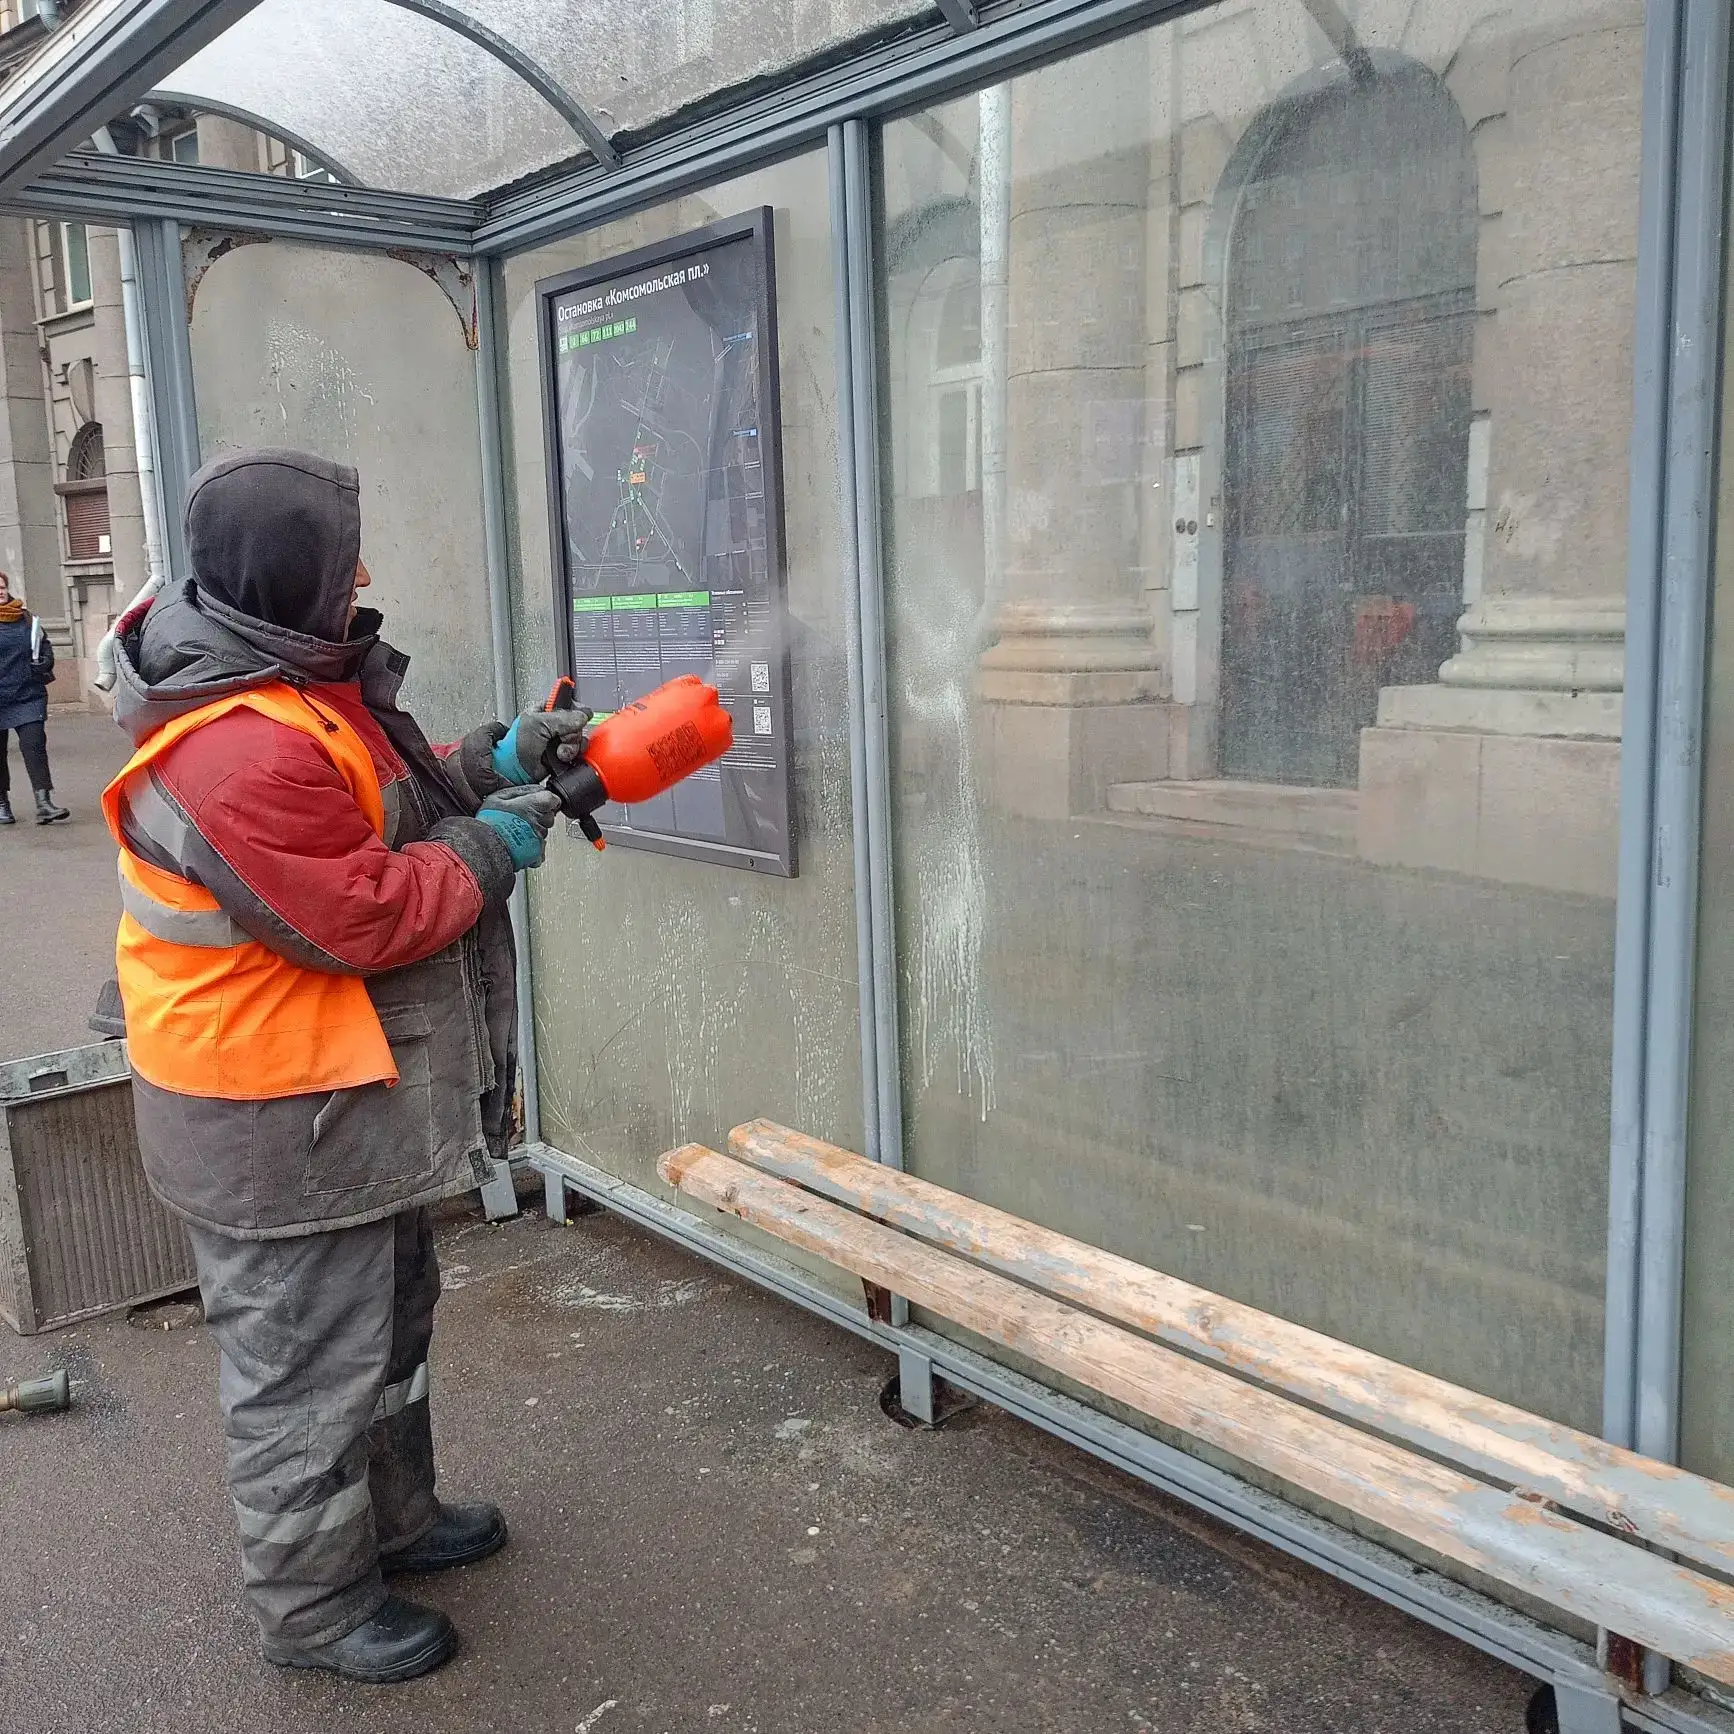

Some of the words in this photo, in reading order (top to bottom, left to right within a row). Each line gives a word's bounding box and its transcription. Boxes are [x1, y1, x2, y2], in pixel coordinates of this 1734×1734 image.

[558, 296, 603, 322] Остановка
[605, 269, 686, 307] «Комсомольская
[687, 263, 710, 281] пл.»
